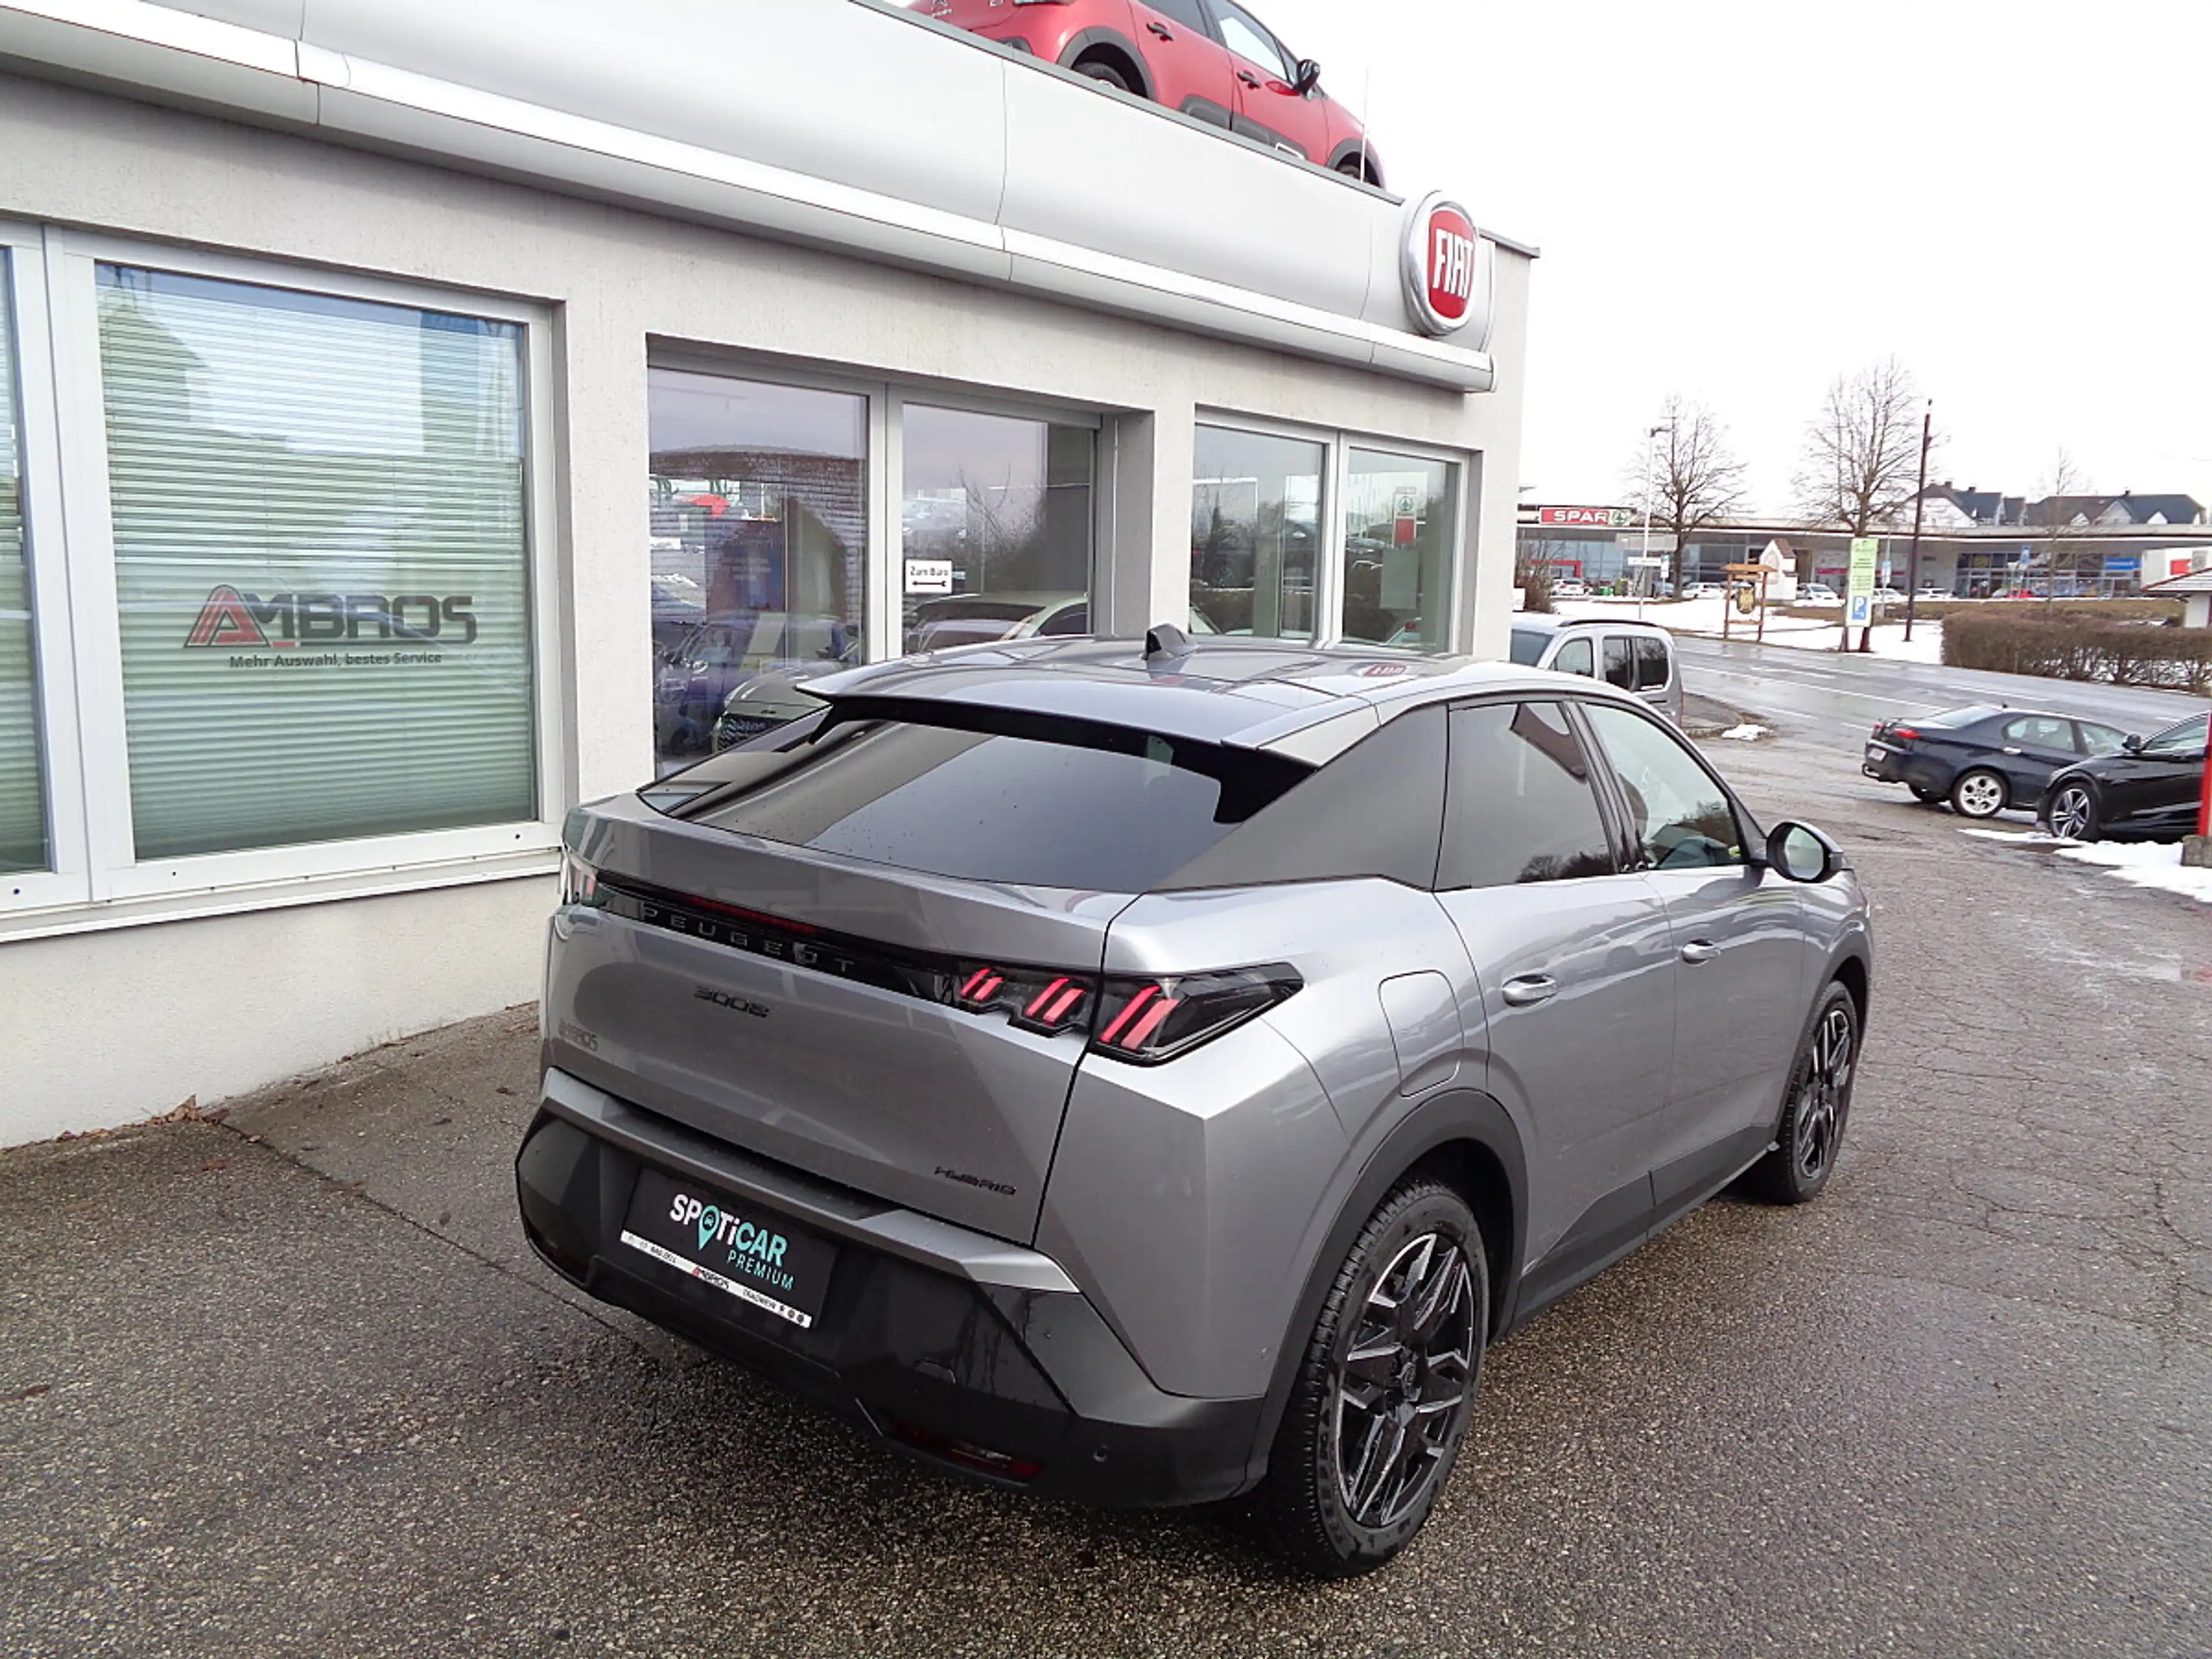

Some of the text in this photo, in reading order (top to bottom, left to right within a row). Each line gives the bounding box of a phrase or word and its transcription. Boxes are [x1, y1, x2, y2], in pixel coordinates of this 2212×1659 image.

[1433, 228, 1474, 299] FIAT
[1553, 510, 1607, 522] SPAR
[910, 566, 927, 575] Zum
[184, 584, 478, 647] AMBROS
[1854, 597, 1865, 611] P
[230, 652, 442, 668] Mehr Auswahl, bestes Service
[641, 905, 854, 972] PEUGEOT
[694, 986, 770, 1018] 3008
[934, 1166, 1017, 1196] HYBRID
[726, 1249, 794, 1291] PREMIUM
